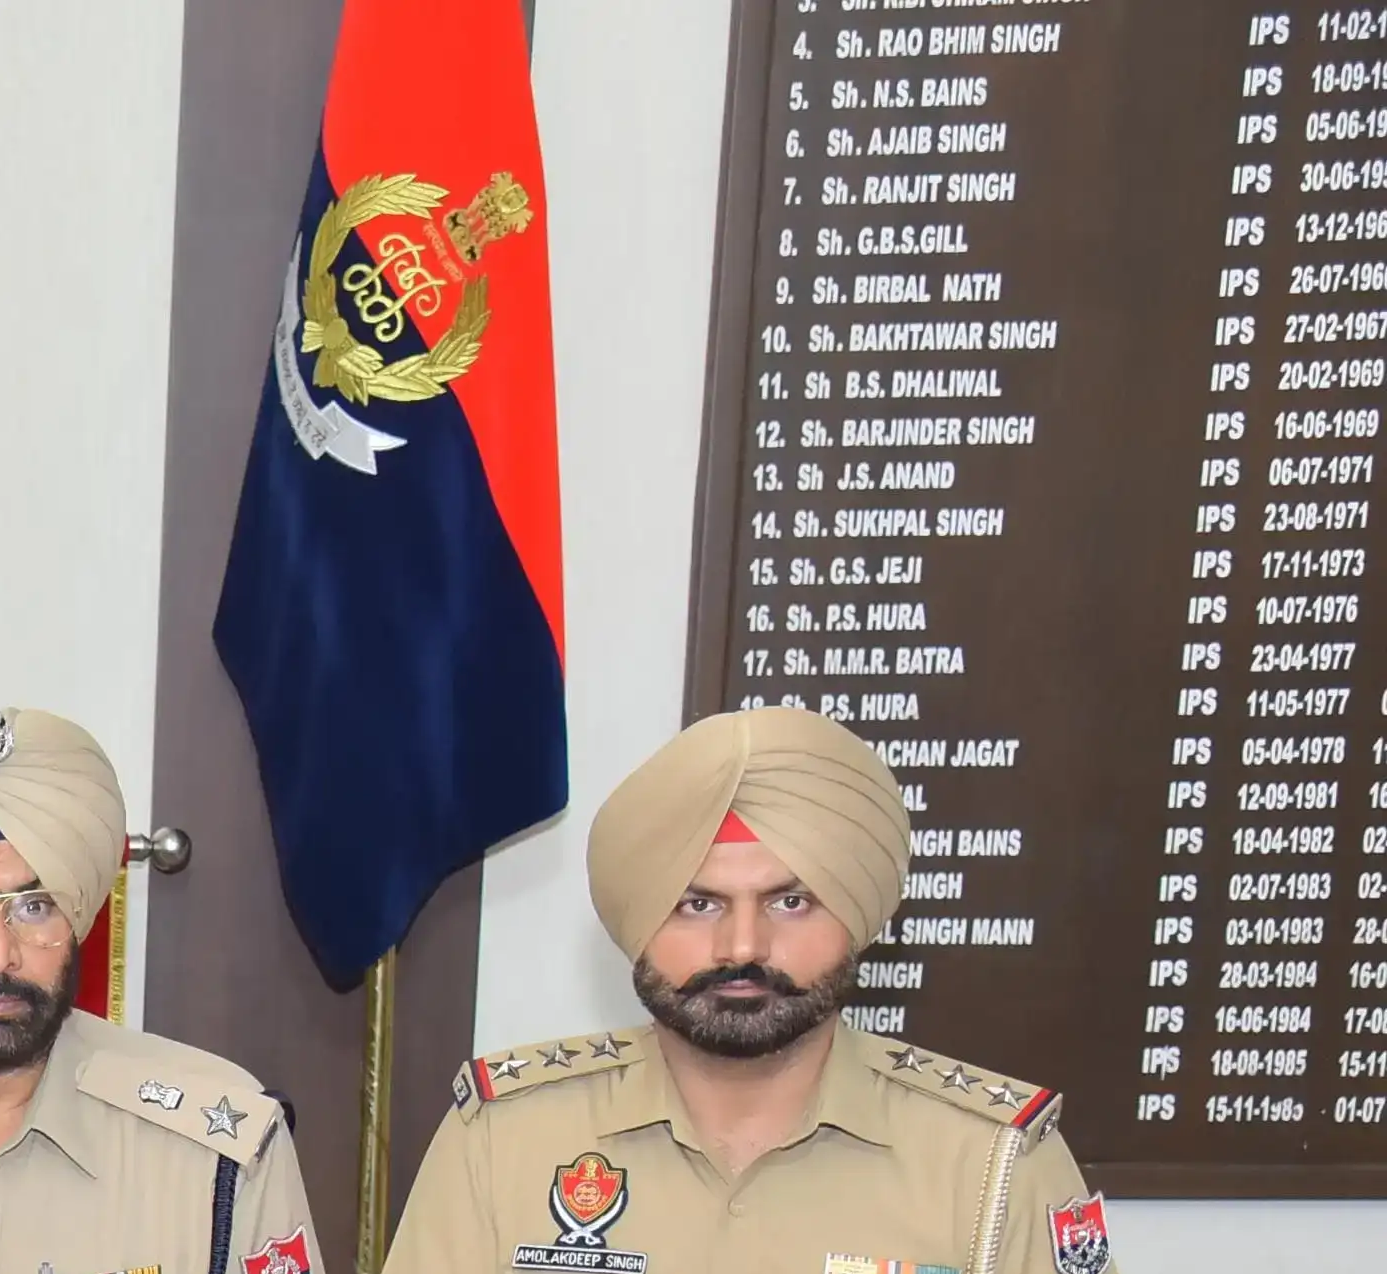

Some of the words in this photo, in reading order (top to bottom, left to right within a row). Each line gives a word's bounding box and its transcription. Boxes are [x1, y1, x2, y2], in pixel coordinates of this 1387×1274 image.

[792, 30, 813, 60] 4.
[877, 27, 924, 58] RAO
[928, 24, 987, 56] BHIM
[990, 23, 1061, 54] SINGH
[1249, 14, 1290, 46] IPS
[789, 81, 809, 111] 5.
[872, 78, 915, 109] N.S.
[920, 76, 988, 107] BAINS
[1242, 65, 1283, 97] IPS
[785, 128, 805, 158] 6.
[866, 125, 933, 156] AJAIB
[936, 122, 1007, 154] SINGH
[1237, 114, 1278, 145] IPS
[783, 176, 802, 206] 7.
[862, 173, 944, 205] RANJIT
[946, 172, 1016, 203] SINGH
[1231, 163, 1272, 195] IPS
[778, 228, 798, 257] 8.
[1224, 216, 1266, 247] IPS
[775, 276, 795, 305] 9.
[853, 274, 932, 304] BIRBAL
[942, 272, 1002, 302] NATH
[1219, 267, 1260, 298] IPS
[761, 324, 792, 354] 10.
[848, 321, 984, 352] BAKHTAWAR
[987, 320, 1058, 350] SINGH
[1214, 315, 1256, 346] IPS
[1283, 311, 1387, 344] 27-02-1967
[758, 371, 789, 400] 11.
[844, 370, 886, 399] B.S.
[890, 369, 1002, 399] DHALIWAL
[1210, 361, 1251, 392] IPS
[1278, 358, 1385, 391] 20-02-1969
[755, 420, 786, 449] 12.
[841, 417, 962, 447] BARJINDER
[966, 415, 1035, 446] SINGH
[1205, 411, 1245, 441] IPS
[1274, 408, 1380, 440] 16-06-1969
[753, 463, 784, 492] 13.
[836, 461, 875, 491] J.S.
[879, 461, 956, 490] ANAND
[1200, 457, 1240, 487] IPS
[1268, 454, 1374, 486] 06-07-1971
[751, 511, 782, 540] 14.
[833, 508, 931, 538] SUKHPAL
[935, 507, 1004, 537] SINGH
[1196, 503, 1236, 533] IPS
[1263, 500, 1369, 532] 23-08-1971
[749, 557, 779, 586] 15.
[829, 556, 871, 585] G.S.
[875, 555, 923, 585] JEJI
[1192, 549, 1232, 579] IPS
[1261, 548, 1365, 579] 17-11-1973
[746, 604, 775, 632] 16.
[825, 603, 862, 632] P.S.
[866, 602, 927, 631] HURA
[1187, 595, 1228, 625] IPS
[1255, 594, 1359, 625] 10-07-1976
[743, 649, 773, 677] 17.
[823, 647, 890, 675] M.M.R.
[895, 646, 965, 675] BATRA
[1181, 642, 1222, 671] IPS
[1250, 642, 1356, 673] 23-04-1977
[860, 693, 920, 721] HURA
[1178, 687, 1218, 716] IPS
[1246, 687, 1351, 717] 11-05-1977
[867, 740, 946, 767] ACHAN
[950, 739, 1020, 768] JAGAT
[1172, 737, 1212, 765] IPS
[1242, 736, 1346, 766] 05-04-1978
[1167, 780, 1207, 809] IPS
[1237, 781, 1339, 811] 12-09-1981
[957, 829, 1022, 857] BAINS
[1164, 826, 1204, 855] IPS
[1232, 825, 1335, 855] 18-04-1982
[1159, 874, 1198, 902] IPS
[1229, 872, 1332, 901] 02-07-1983
[900, 918, 967, 946] SINGH
[970, 918, 1035, 946] MANN
[1154, 916, 1193, 946] IPS
[1225, 917, 1324, 946] 03-10-1983
[858, 962, 923, 990] SINGH
[1149, 959, 1188, 987] IPS
[1219, 960, 1318, 989] 28-03-1984
[840, 1006, 906, 1034] SINGH
[1145, 1005, 1185, 1033] IPS
[1215, 1005, 1312, 1033] 16-06-1984
[1141, 1046, 1181, 1075] IPS
[1210, 1049, 1308, 1076] 18-08-1985
[1137, 1093, 1176, 1121] IPS
[516, 1249, 601, 1267] AMOLAKDEEP
[605, 1254, 643, 1271] SINGH
